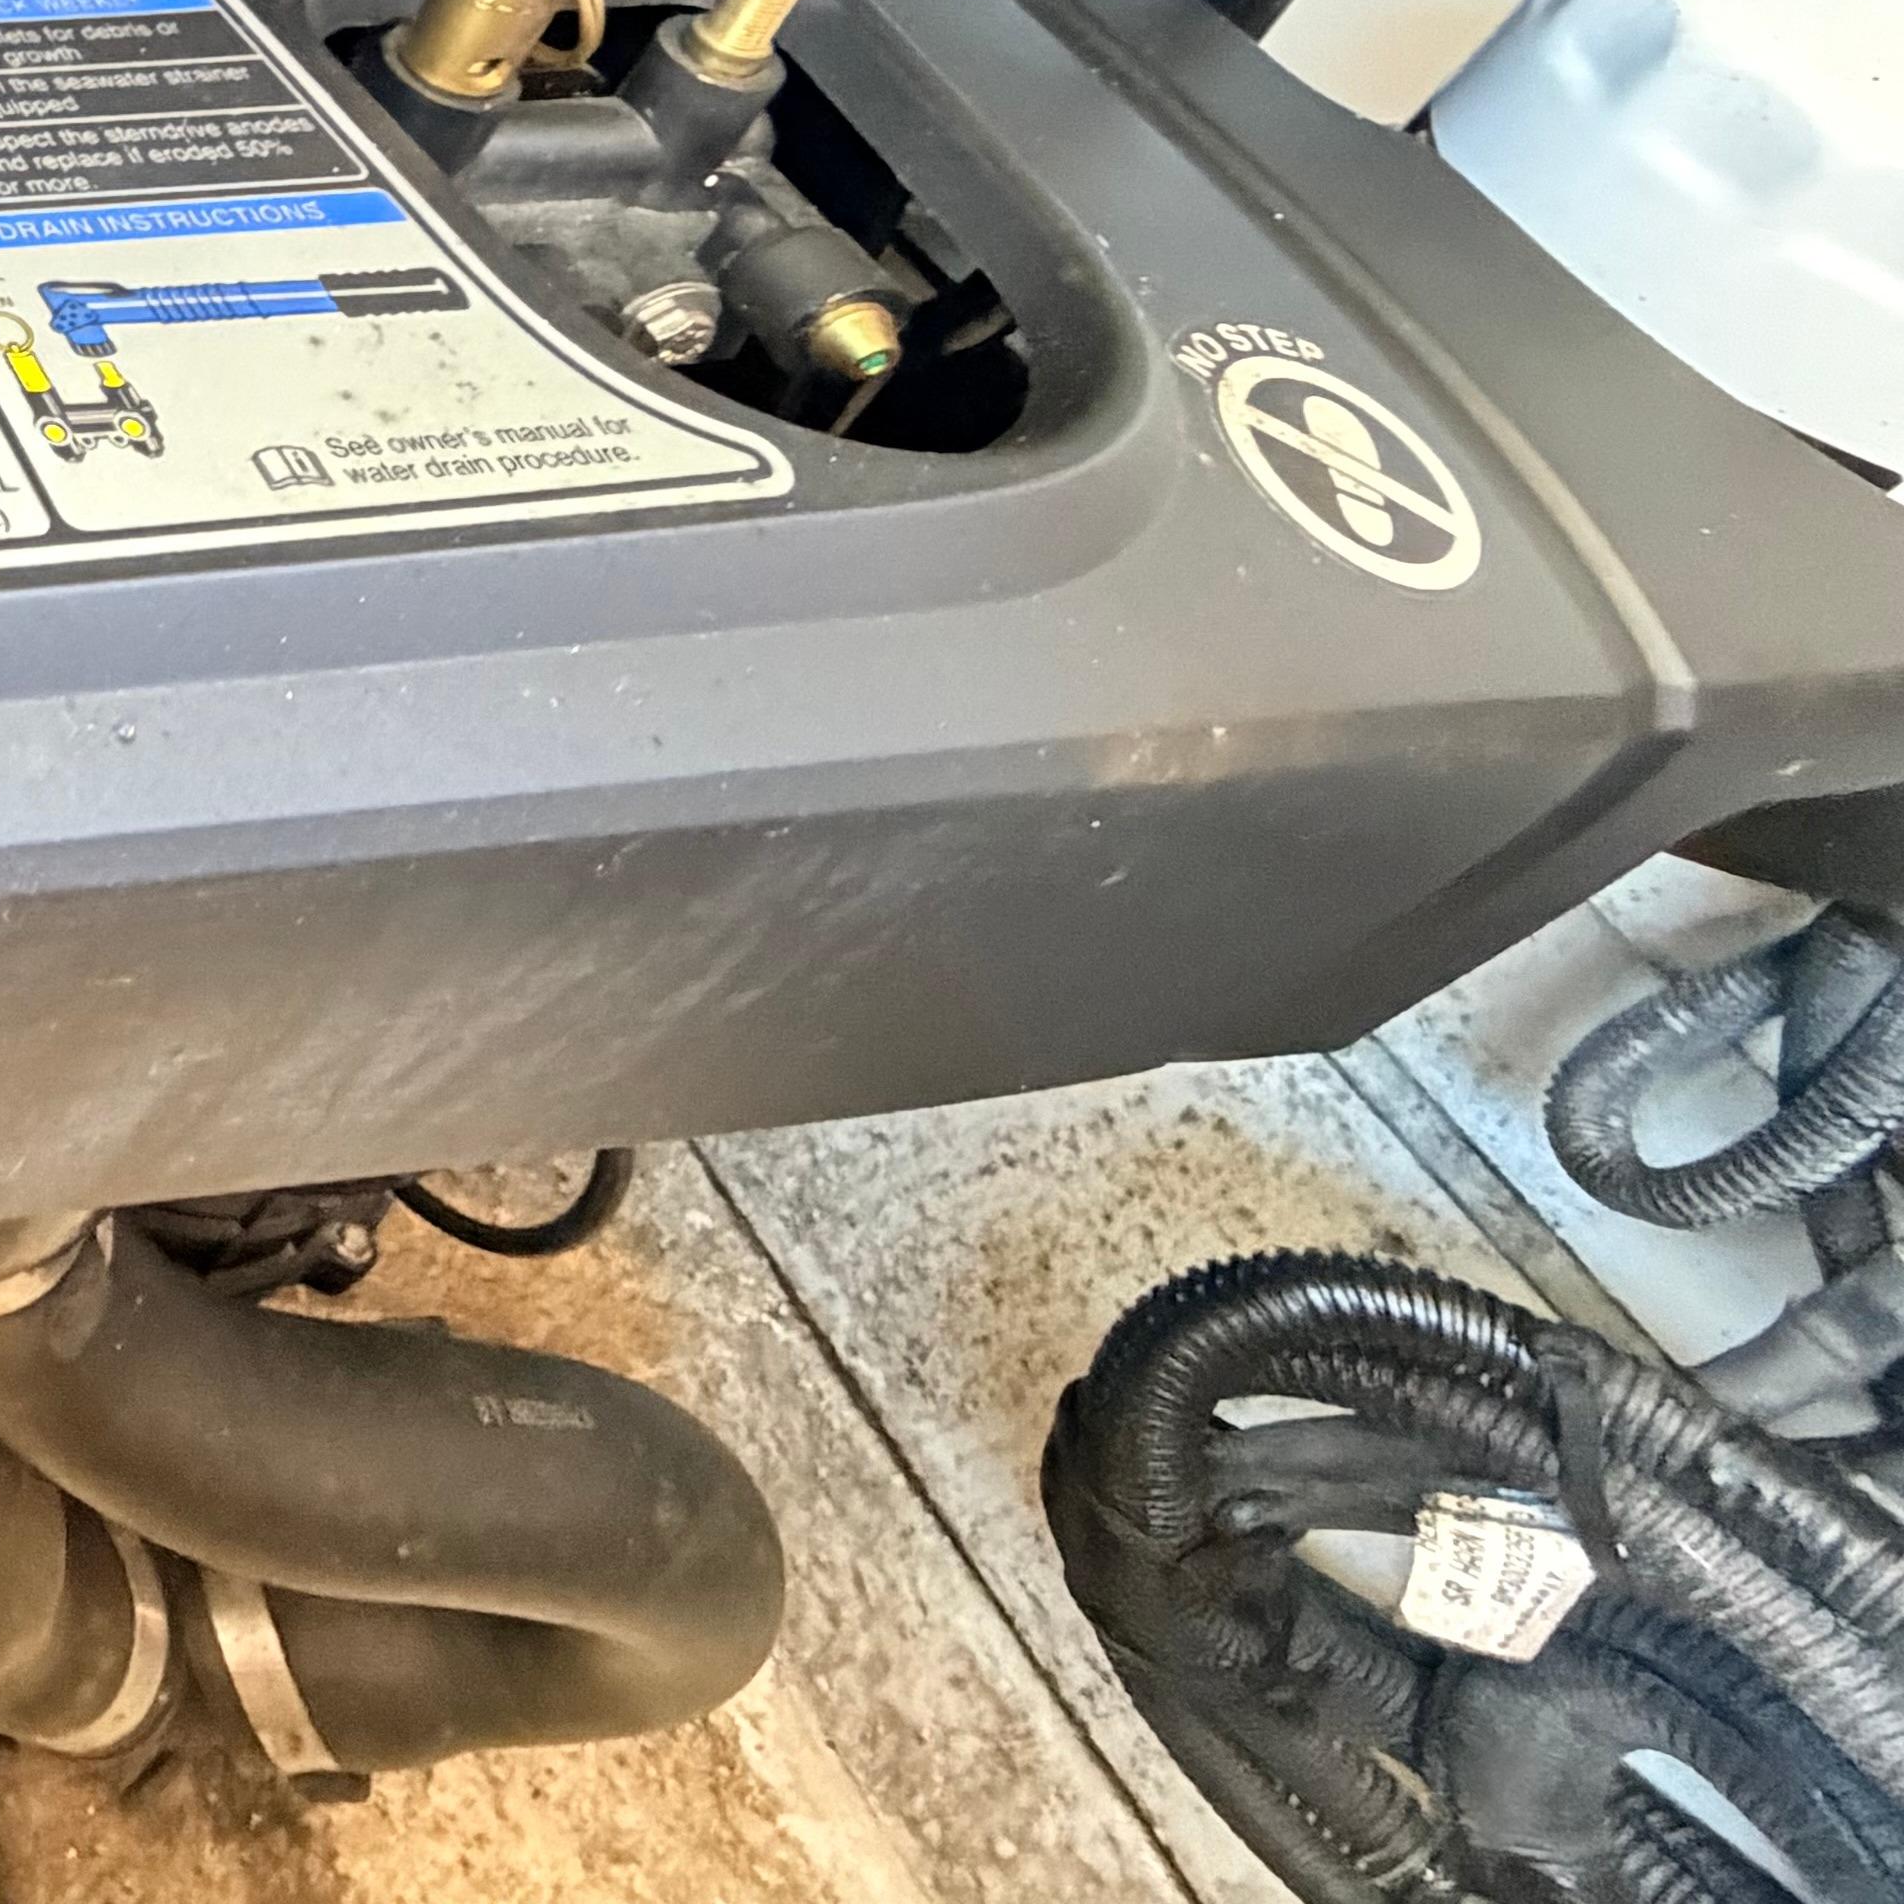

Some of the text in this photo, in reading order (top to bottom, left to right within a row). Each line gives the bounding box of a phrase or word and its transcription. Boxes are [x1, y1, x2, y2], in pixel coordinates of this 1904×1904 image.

[7, 77, 49, 92] the
[52, 71, 157, 91] seawater
[162, 66, 249, 85] strainer
[96, 200, 325, 233] INSTRUCTIONS
[1176, 323, 1325, 377] NO STEP
[324, 416, 633, 457] See owner's manual for
[342, 446, 639, 483] water drain procedure.
